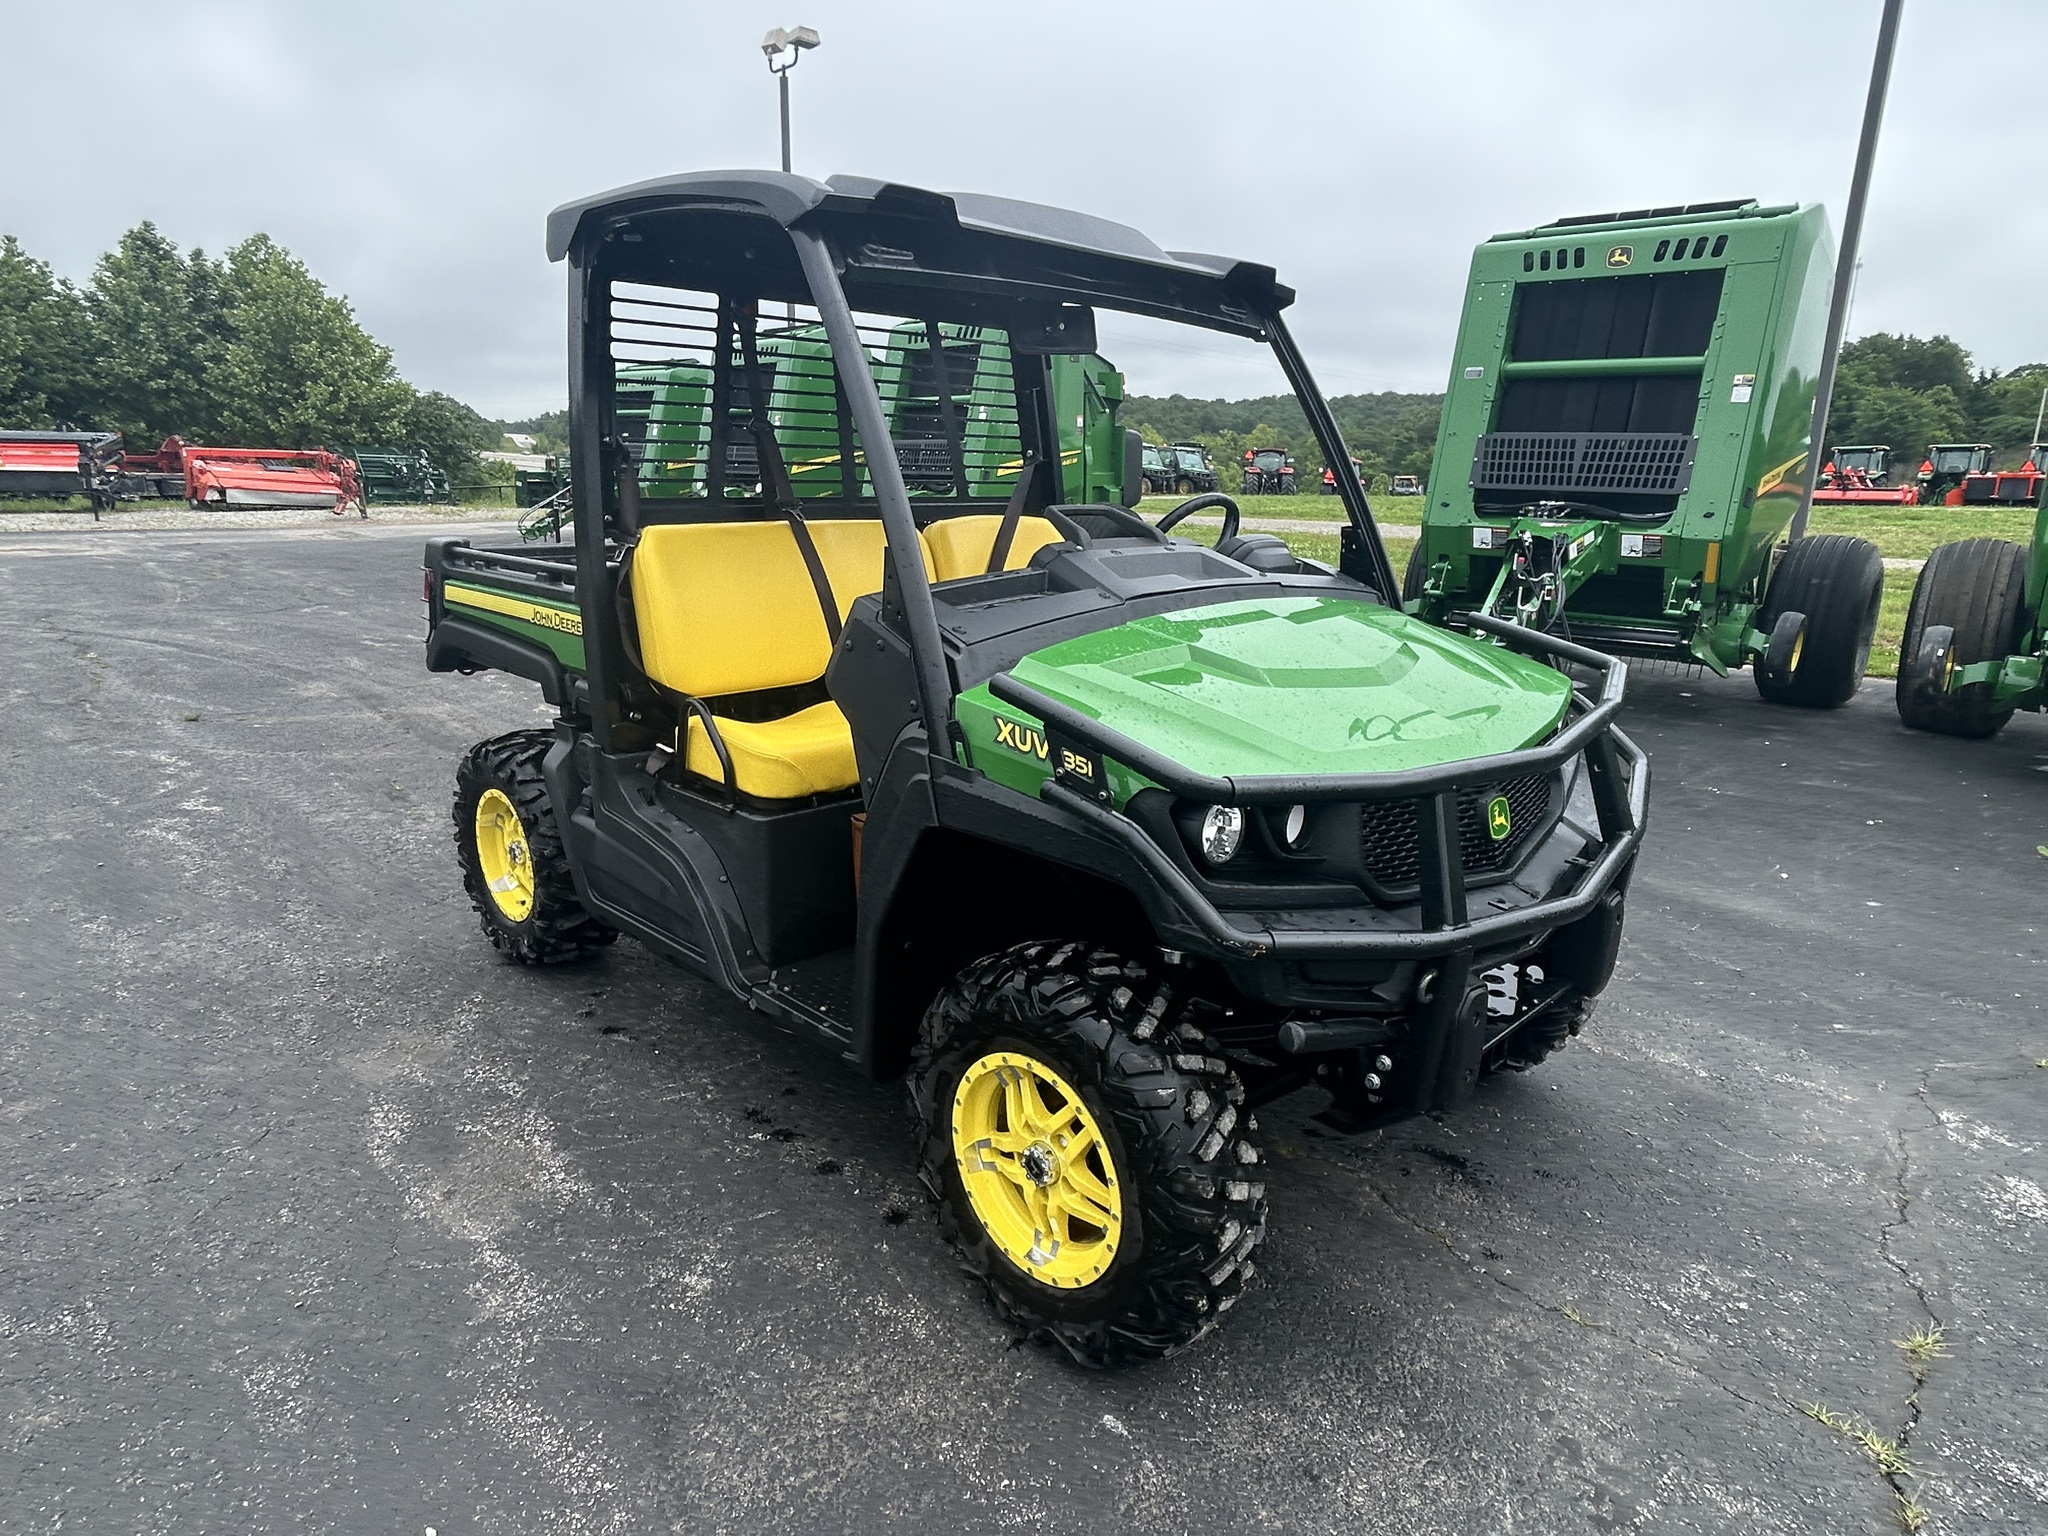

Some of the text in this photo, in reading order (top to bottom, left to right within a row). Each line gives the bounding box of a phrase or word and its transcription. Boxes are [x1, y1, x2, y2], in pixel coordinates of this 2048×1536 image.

[531, 607, 582, 634] JOHN DEERE
[995, 716, 1049, 760] XUV
